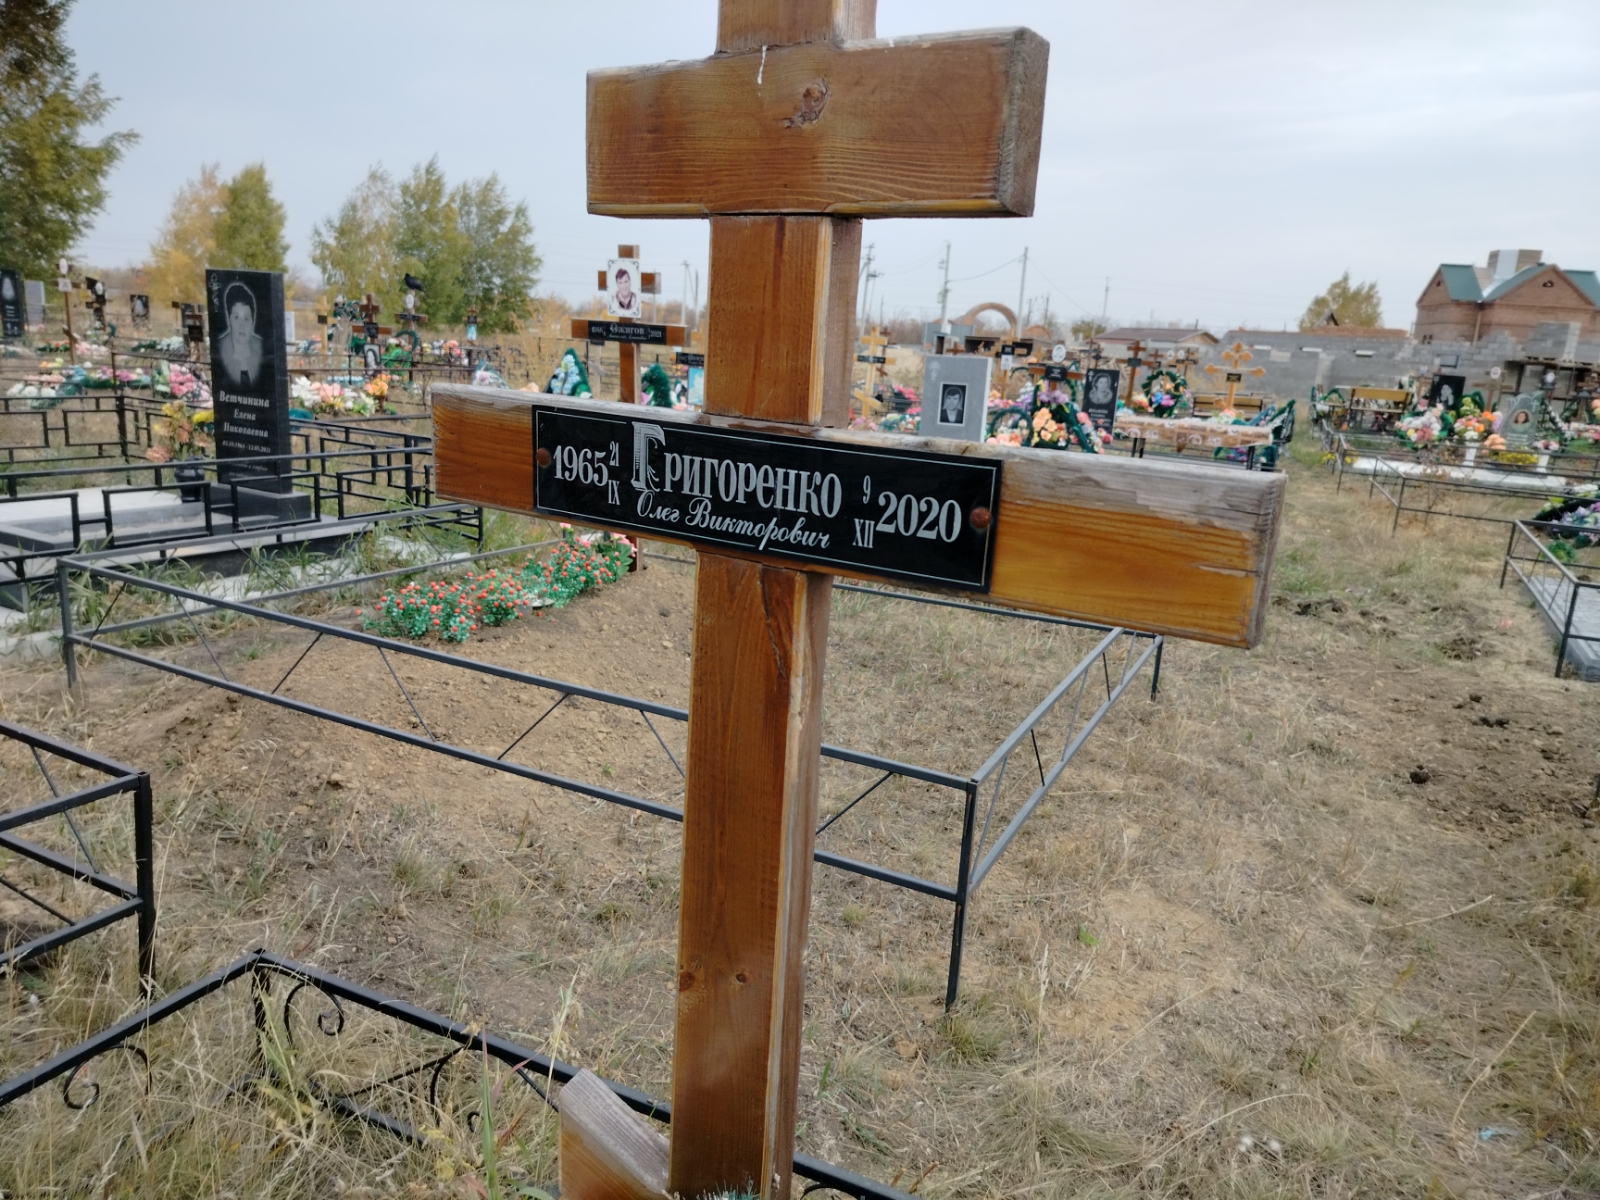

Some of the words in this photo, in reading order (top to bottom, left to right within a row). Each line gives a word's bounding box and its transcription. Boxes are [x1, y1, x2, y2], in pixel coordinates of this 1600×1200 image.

[219, 390, 270, 408] Ветчинина
[233, 408, 256, 421] Елена
[223, 422, 269, 438] Николаевна
[551, 445, 609, 487] 1965
[609, 441, 619, 467] 21
[630, 421, 842, 518] Григоренко
[608, 480, 620, 505] IX
[863, 475, 871, 504] 9
[637, 490, 680, 523] Олег
[685, 497, 831, 550] Викторович
[876, 491, 962, 543] 2020
[852, 518, 875, 548] XII
